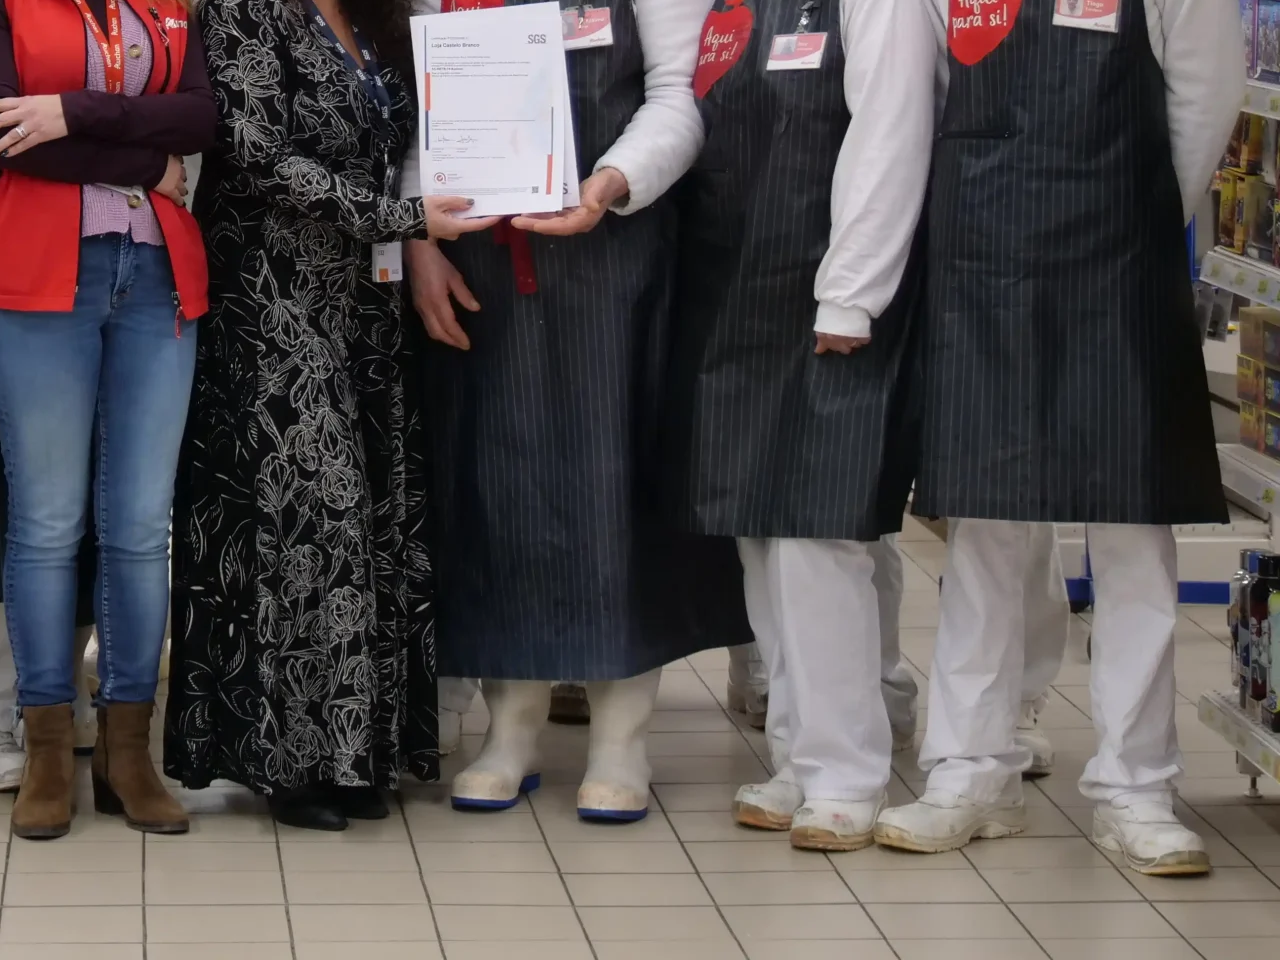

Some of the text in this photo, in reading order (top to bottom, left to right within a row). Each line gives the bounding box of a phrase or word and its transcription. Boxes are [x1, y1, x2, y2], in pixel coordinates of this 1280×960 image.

[951, 3, 1008, 38] para si!
[527, 33, 547, 44] SGS
[704, 26, 735, 47] Aqui
[698, 41, 739, 66] ara si!
